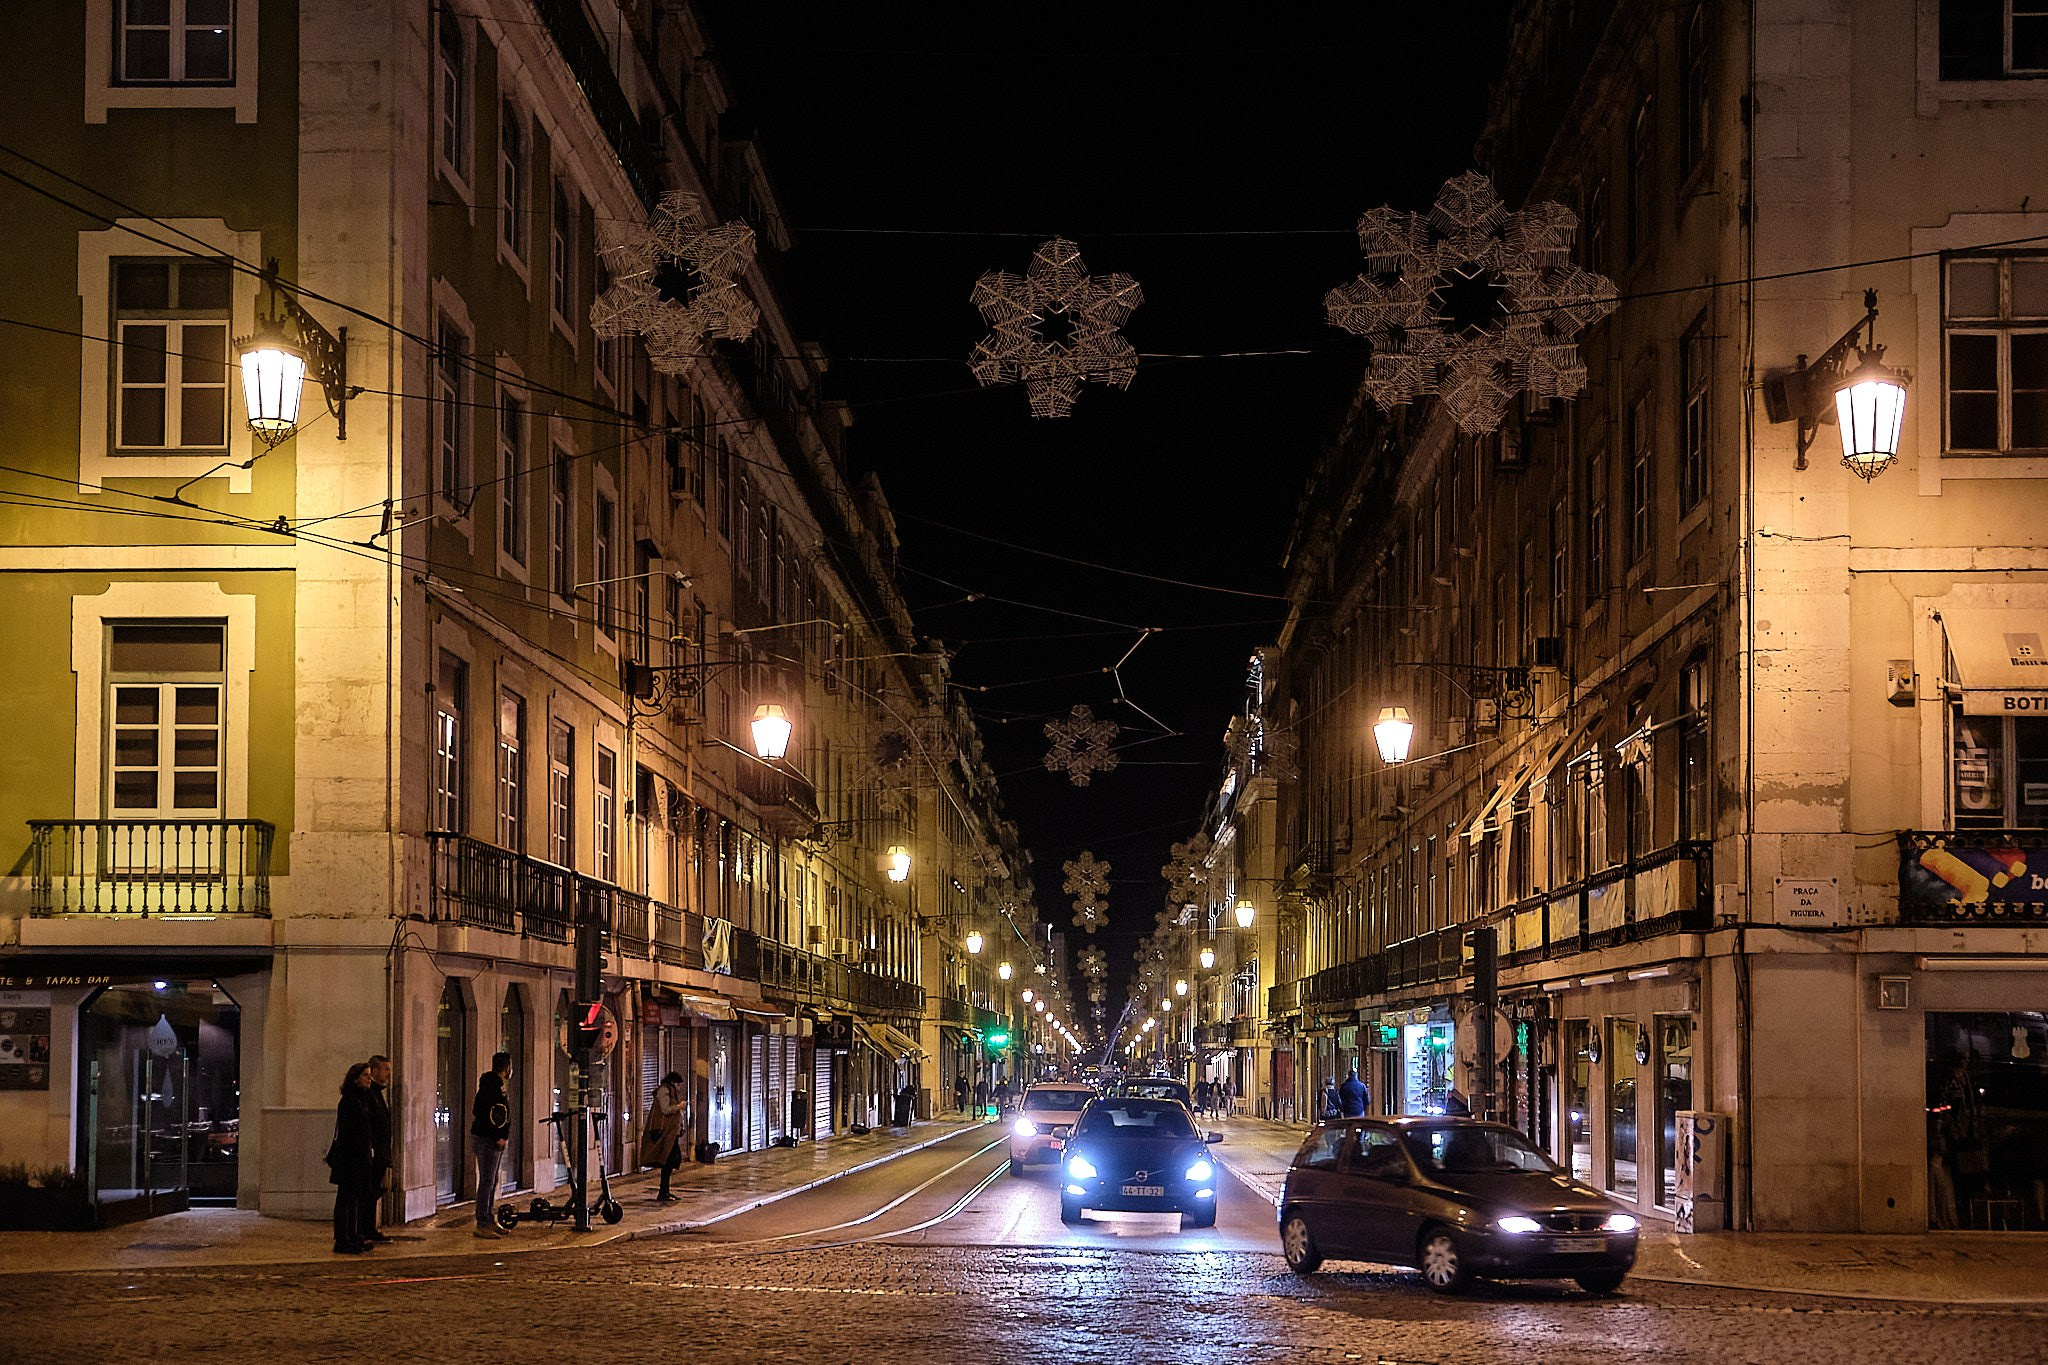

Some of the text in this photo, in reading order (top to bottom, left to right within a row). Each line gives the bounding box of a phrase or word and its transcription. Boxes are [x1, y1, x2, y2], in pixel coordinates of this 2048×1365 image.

[1793, 887, 1819, 896] PRAÇA
[1800, 898, 1812, 906] DA
[1790, 910, 1825, 918] FIGUEIRA
[46, 976, 81, 985] TAPAS
[87, 976, 110, 984] BAR
